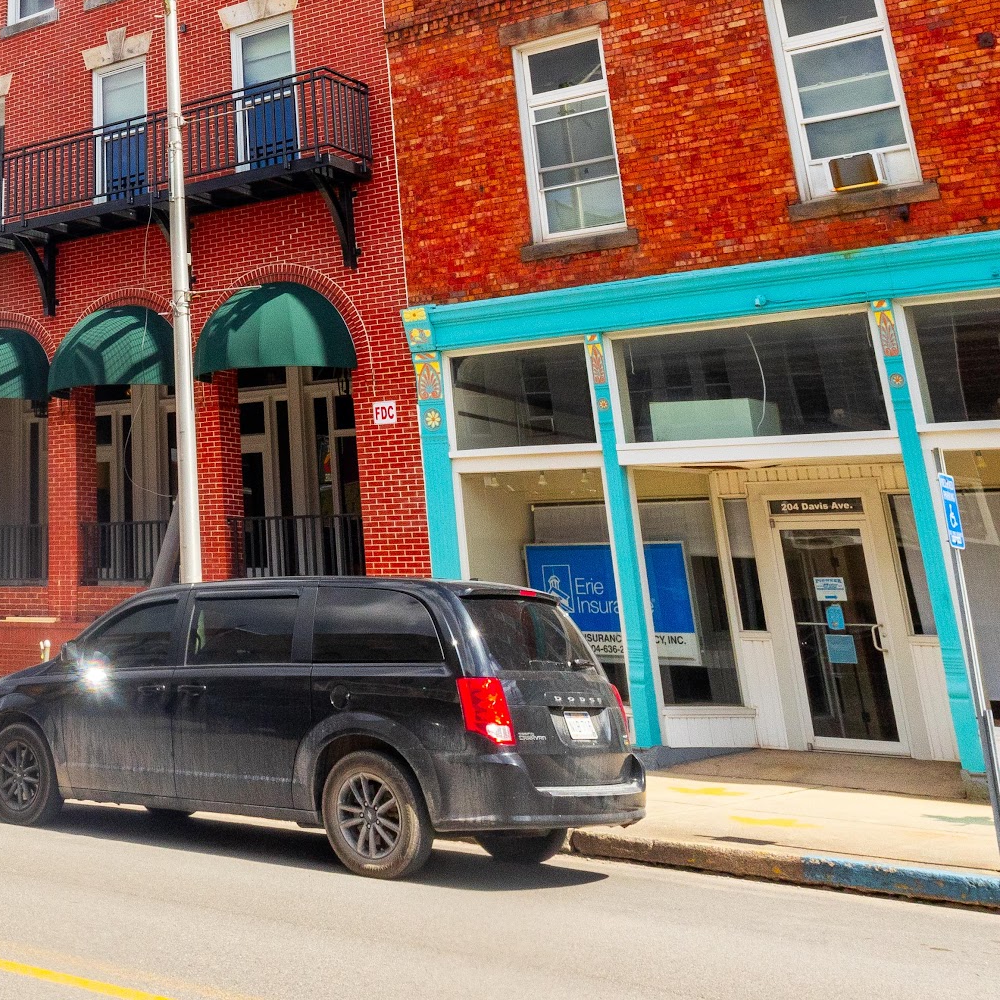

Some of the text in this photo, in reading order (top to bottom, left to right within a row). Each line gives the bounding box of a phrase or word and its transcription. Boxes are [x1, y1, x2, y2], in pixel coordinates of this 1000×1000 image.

[374, 405, 395, 420] FDC
[780, 501, 854, 512] 204 Davis Ave.
[574, 577, 604, 595] Erie
[668, 636, 687, 645] INC.
